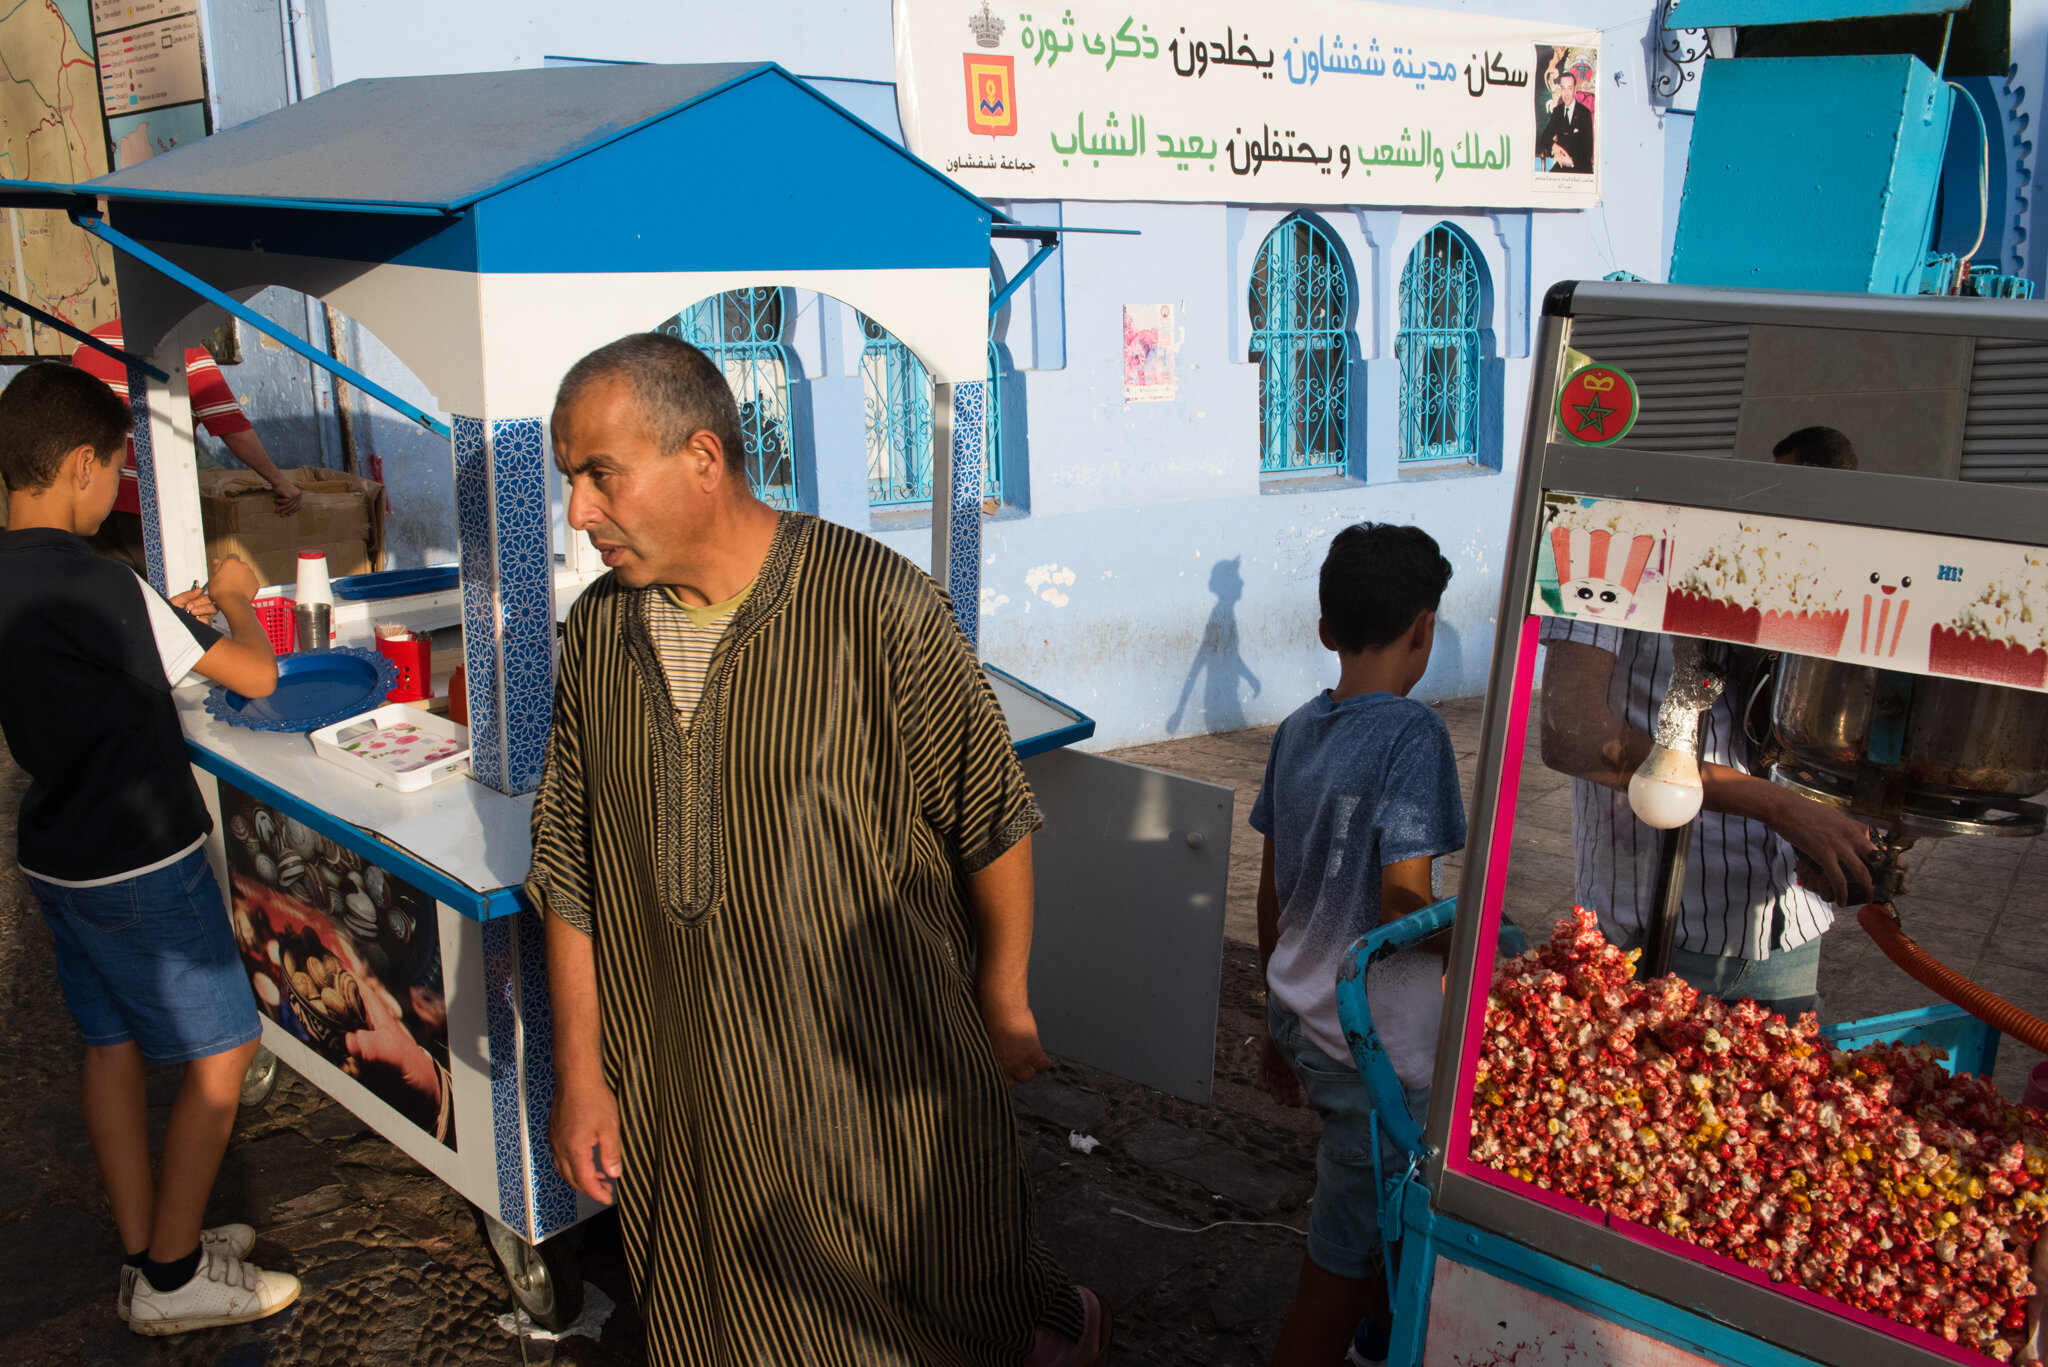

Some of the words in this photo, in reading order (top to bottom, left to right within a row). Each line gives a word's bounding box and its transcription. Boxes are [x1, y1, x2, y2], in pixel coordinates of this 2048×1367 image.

[1019, 9, 1075, 68] ثورة
[1083, 18, 1159, 69] ذكرى
[1168, 26, 1275, 80] يخلدون
[1283, 35, 1386, 85] شفشاون
[1392, 47, 1457, 90] مدينة
[1464, 51, 1529, 98] سكان
[1050, 110, 1145, 167] الشباب
[1156, 134, 1217, 171] بعيد
[1358, 127, 1444, 180] والشعب
[1450, 131, 1511, 170] الملك
[945, 153, 997, 173] شفشاون
[1000, 155, 1036, 174] جماعة
